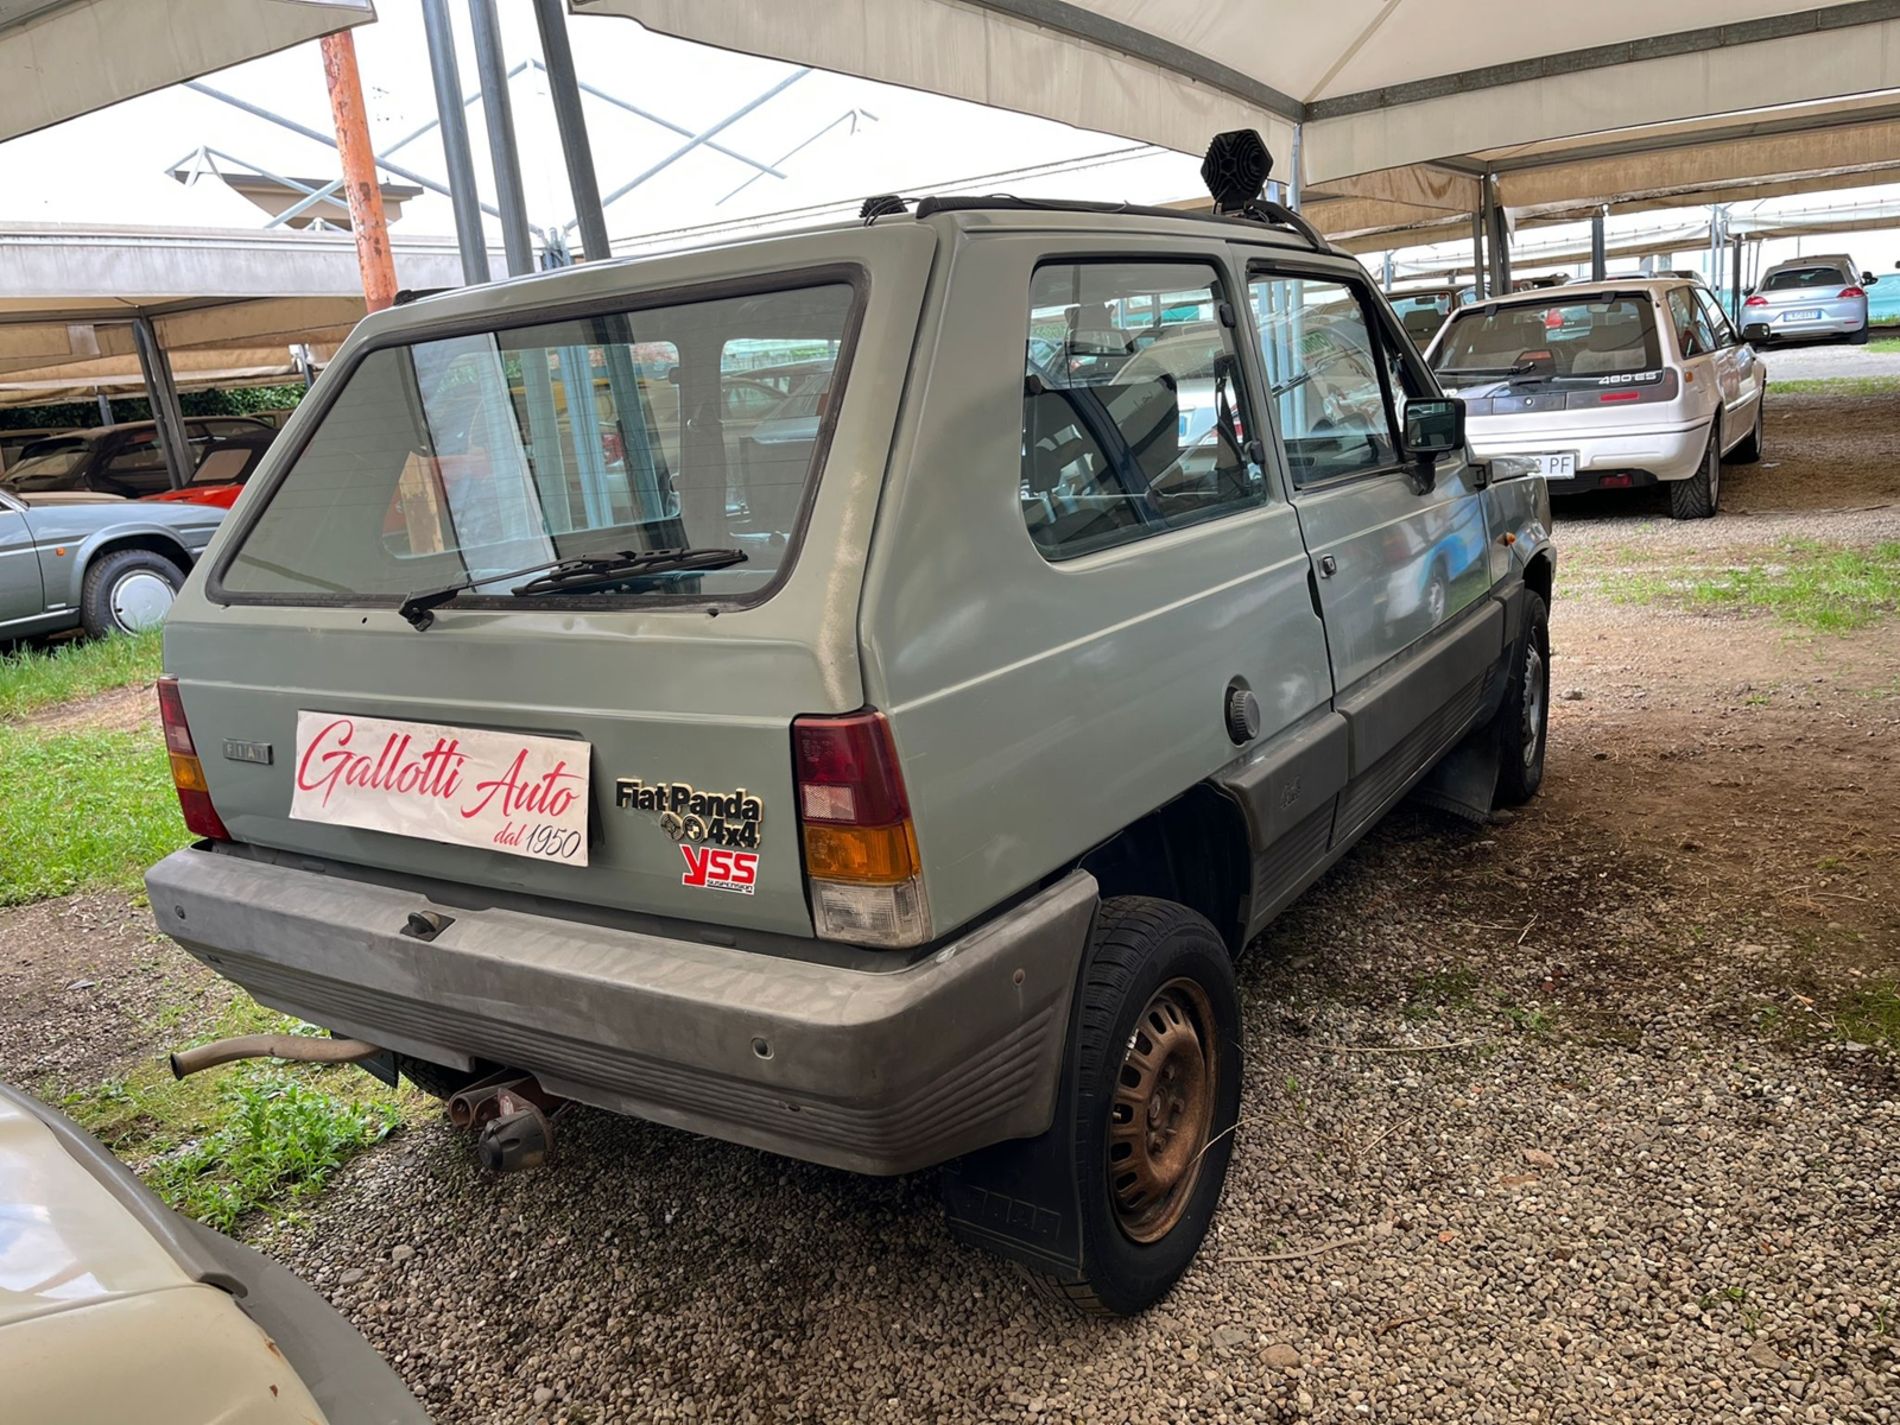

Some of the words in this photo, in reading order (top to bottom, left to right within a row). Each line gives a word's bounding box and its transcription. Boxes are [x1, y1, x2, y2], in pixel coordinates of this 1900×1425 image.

[298, 720, 473, 808] Gallotti
[461, 749, 584, 817] Auto
[616, 778, 669, 811] Fiat
[671, 783, 763, 822] Panda
[493, 821, 527, 847] dal
[525, 823, 582, 858] 1950
[707, 817, 760, 848] 4x4
[682, 846, 757, 886] YSS
